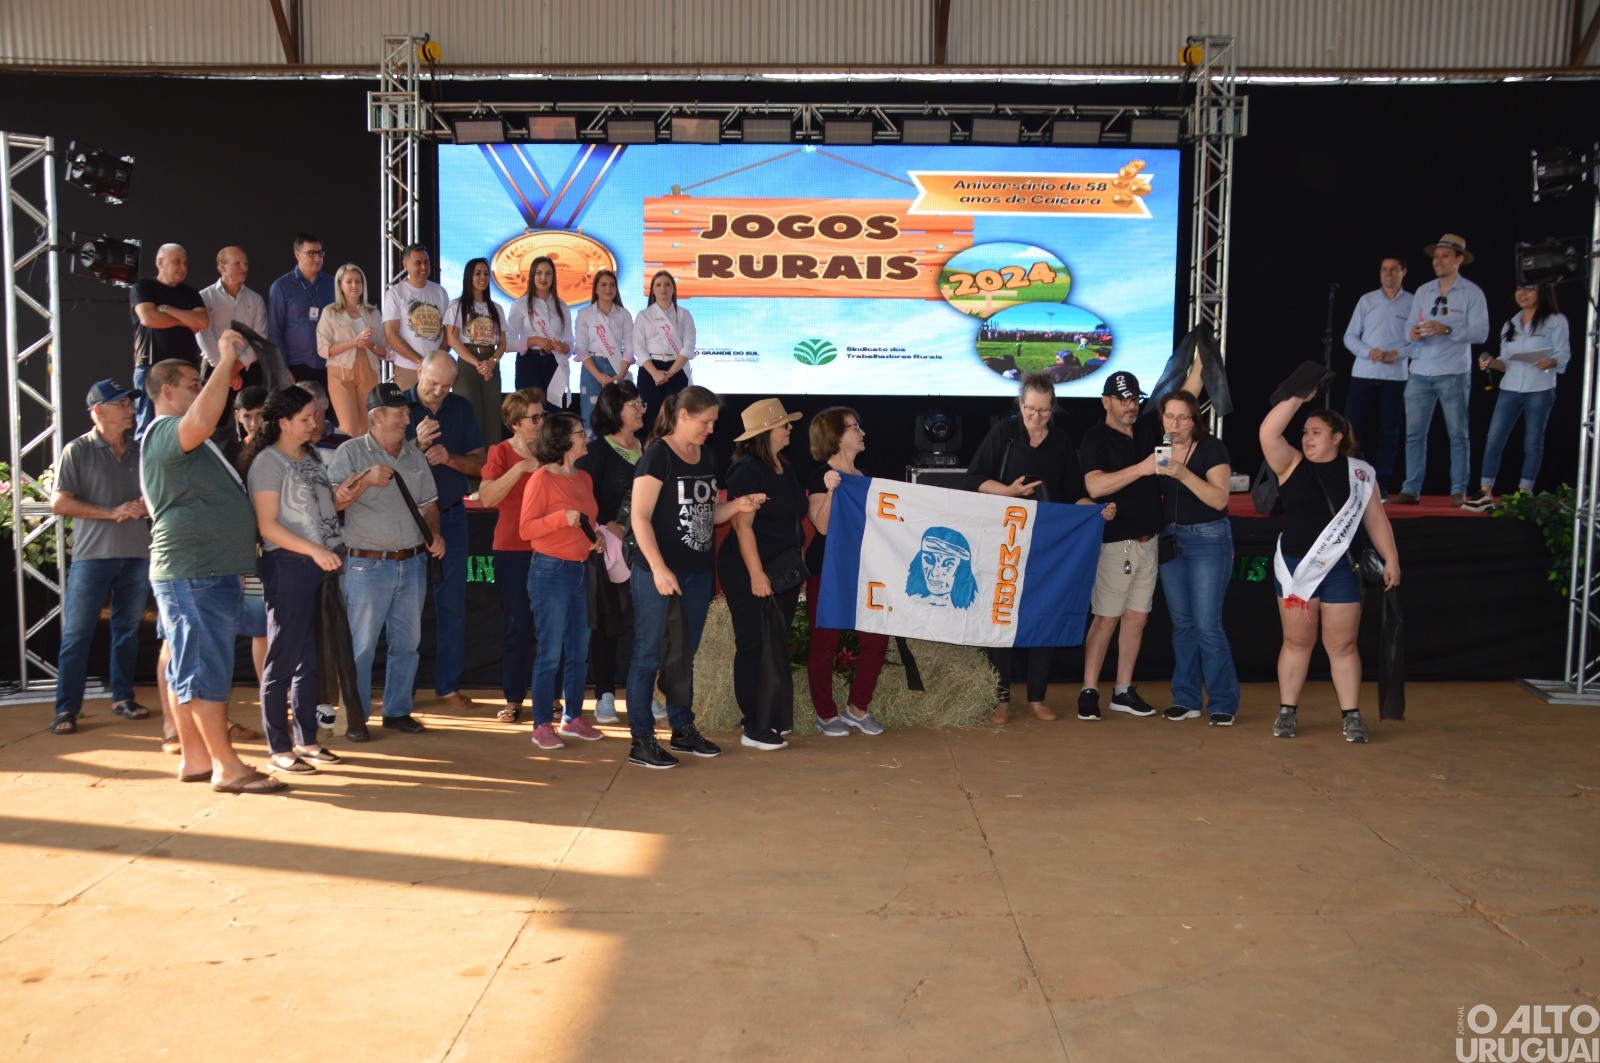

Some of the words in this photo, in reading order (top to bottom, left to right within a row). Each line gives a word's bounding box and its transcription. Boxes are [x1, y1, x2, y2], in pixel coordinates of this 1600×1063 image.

[953, 179, 1056, 191] Aniversário
[1060, 182, 1081, 191] de
[1085, 182, 1107, 191] 58
[959, 195, 1001, 203] anos
[1005, 194, 1026, 204] de
[1030, 194, 1101, 206] Caiçara
[699, 213, 900, 240] JOGOS
[697, 253, 919, 281] RURAIS
[948, 261, 1057, 297] 2024
[594, 324, 616, 357] Rainha
[1116, 376, 1133, 398] CHILE
[877, 492, 904, 522] E.
[866, 581, 893, 612] C.
